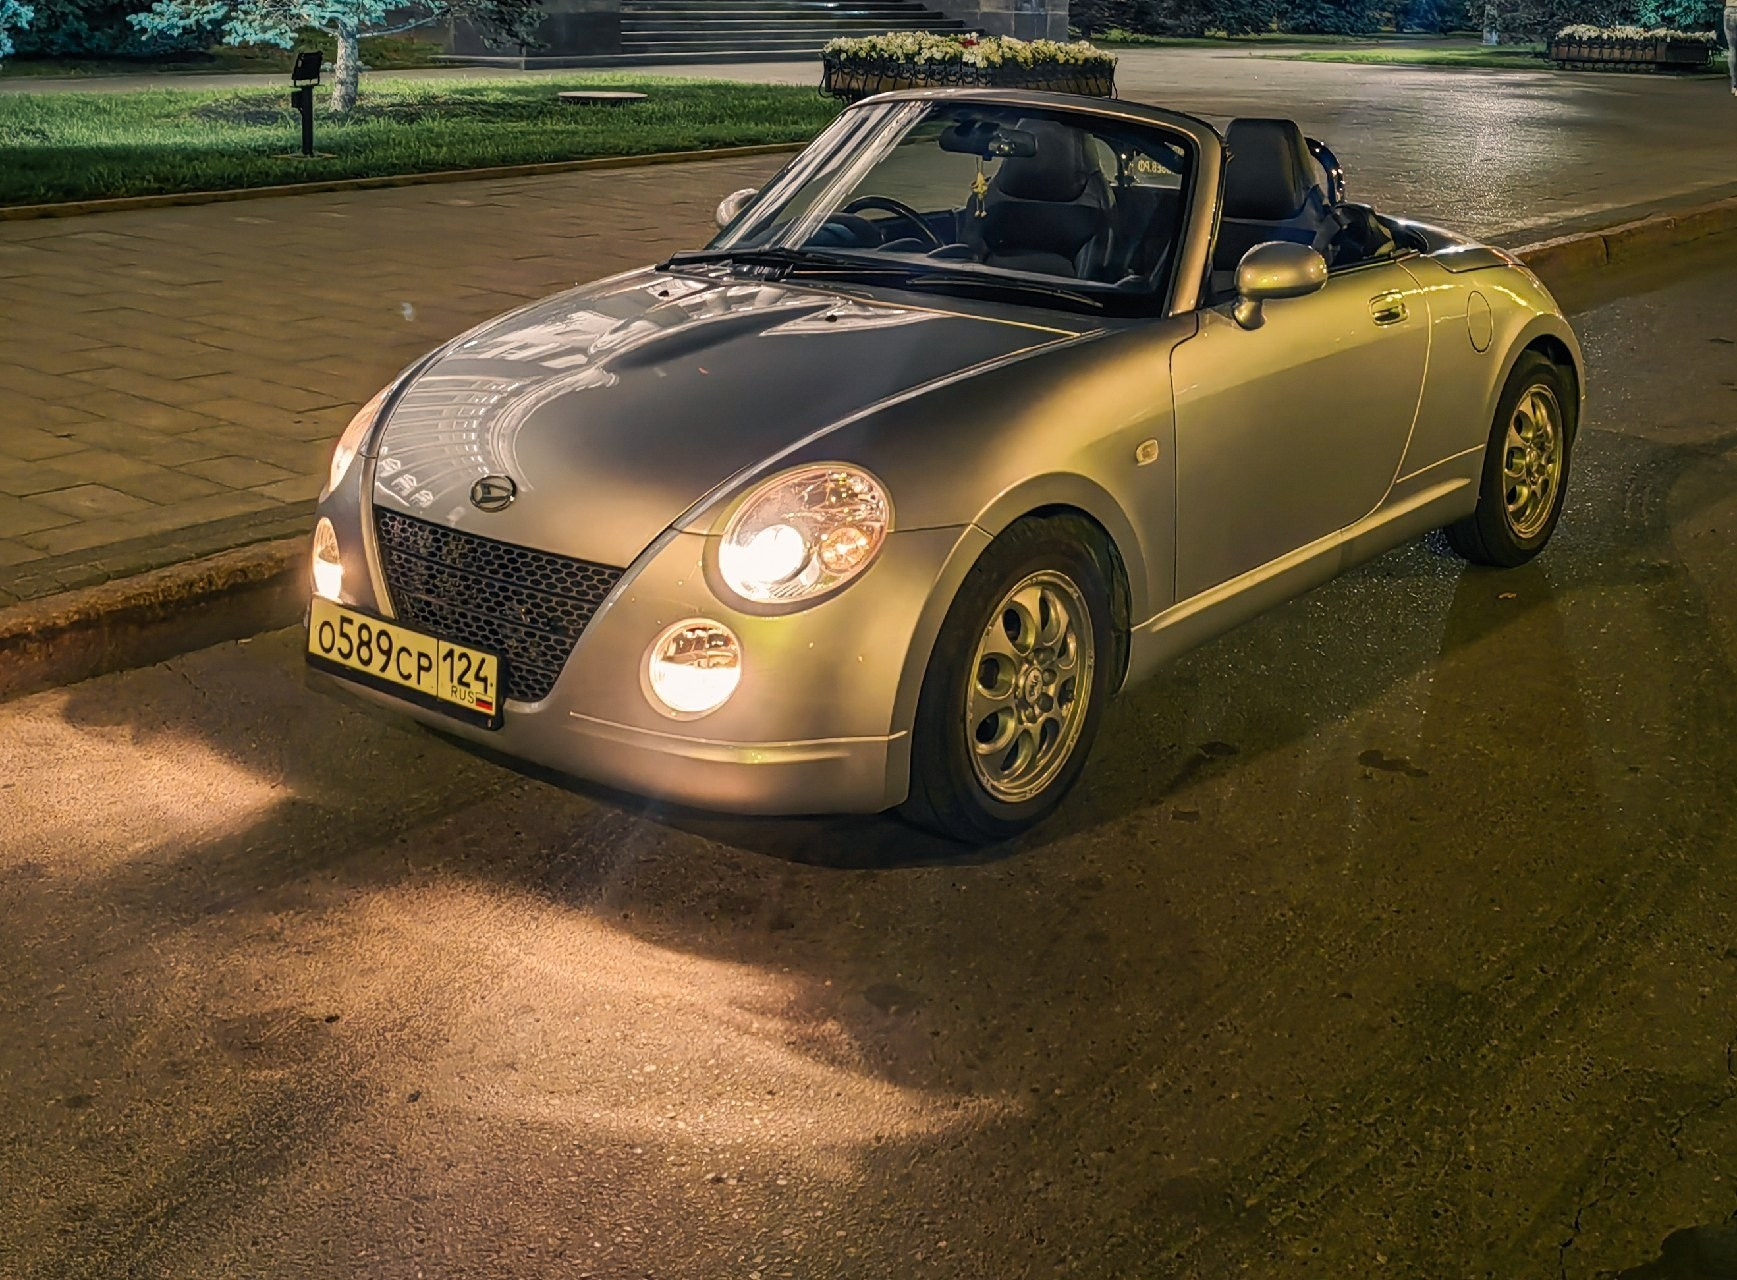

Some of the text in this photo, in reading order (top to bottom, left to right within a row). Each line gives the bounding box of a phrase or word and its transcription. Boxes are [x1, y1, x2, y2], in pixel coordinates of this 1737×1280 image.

[318, 615, 489, 694] О589СР 124
[451, 685, 475, 704] RUS
